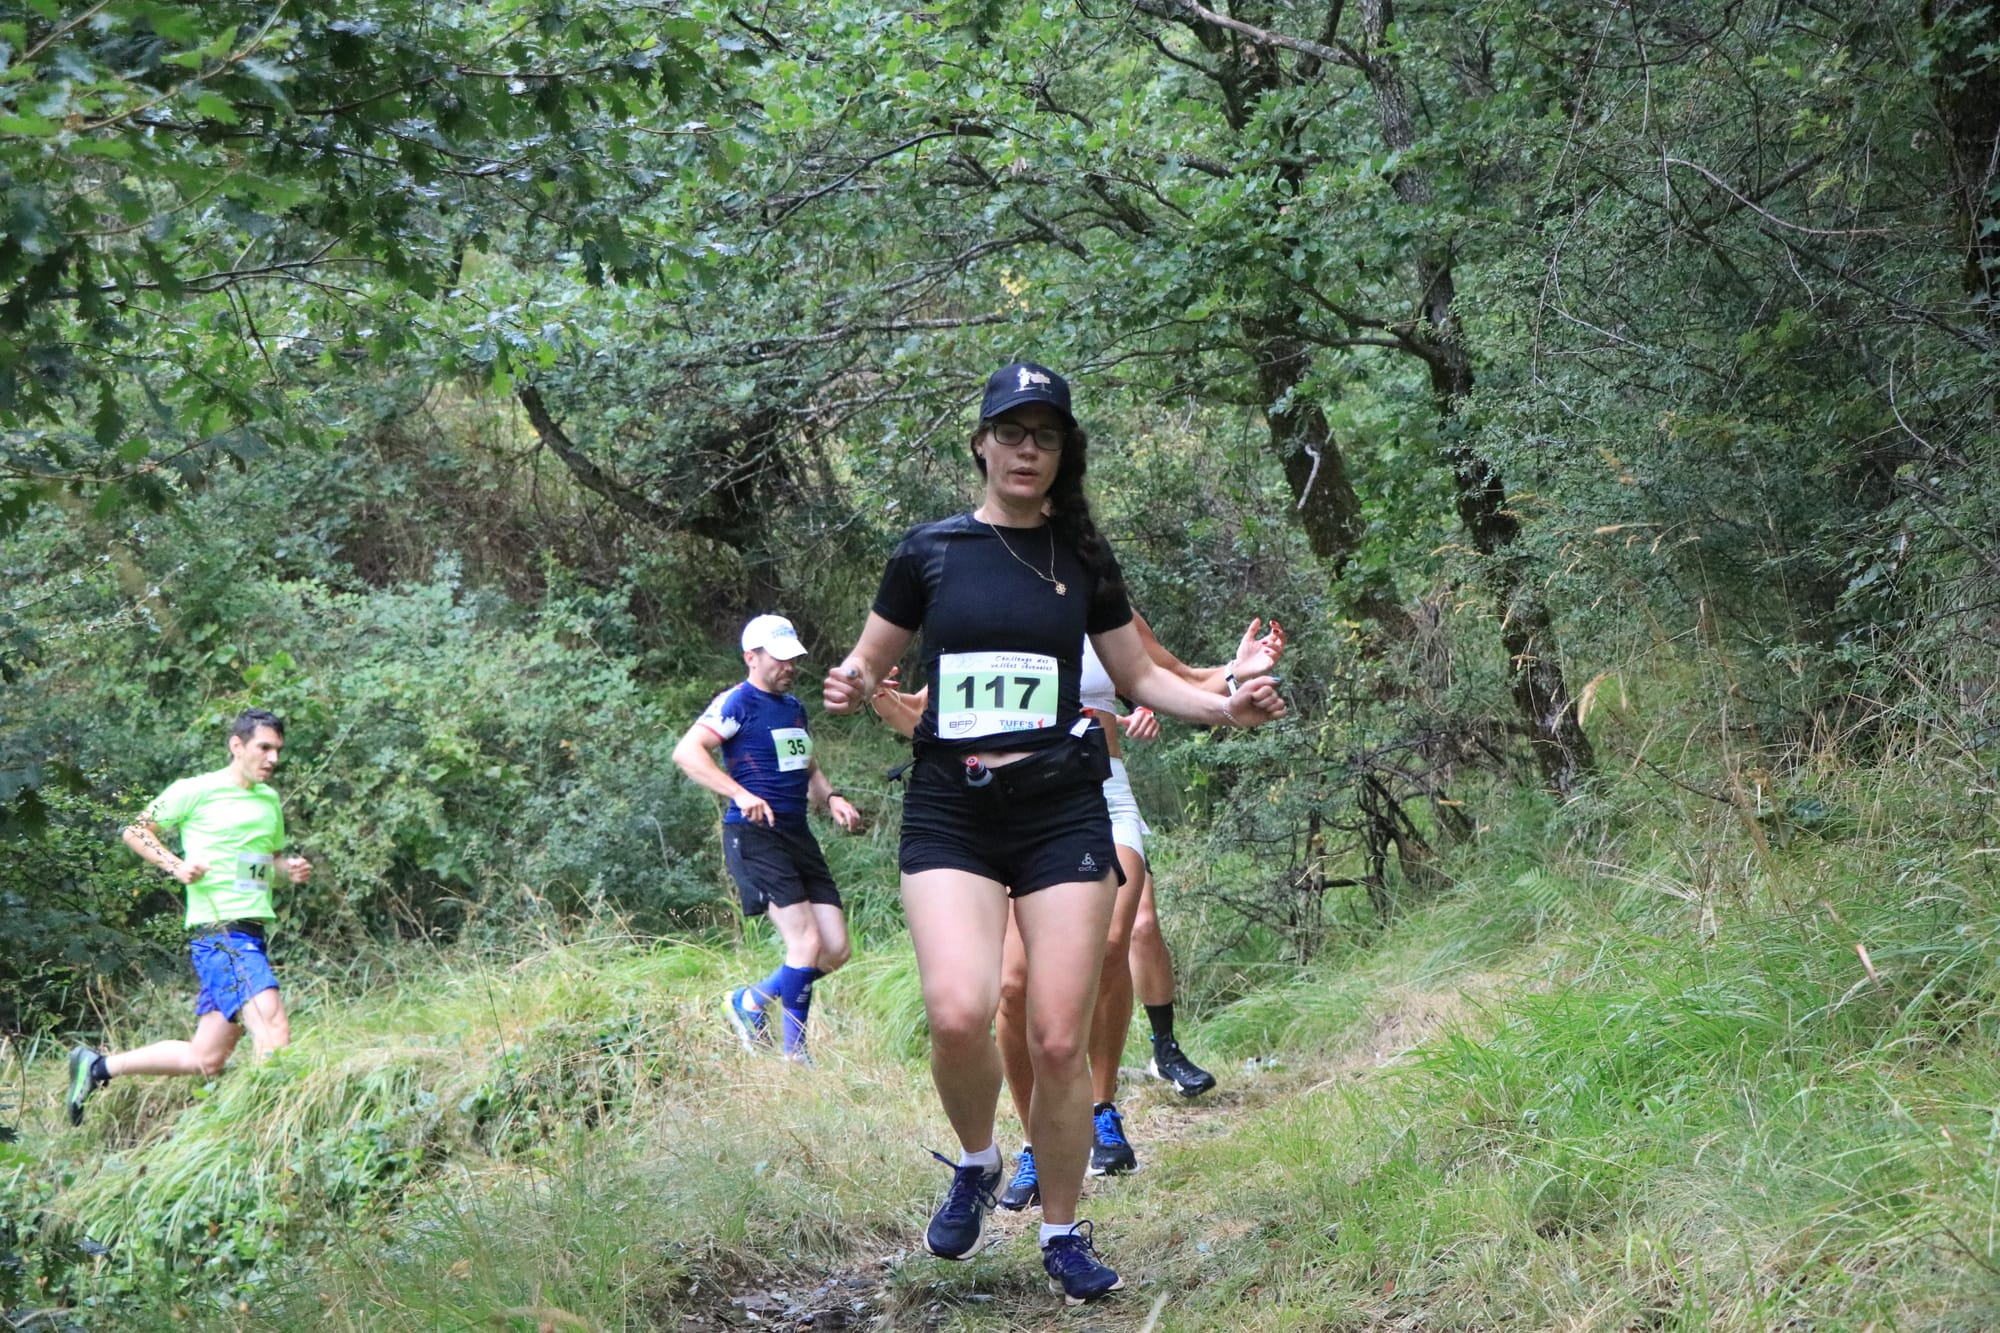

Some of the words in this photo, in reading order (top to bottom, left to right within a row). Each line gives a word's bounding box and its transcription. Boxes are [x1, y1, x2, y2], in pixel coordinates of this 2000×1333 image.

[957, 675, 1041, 710] 117
[1000, 719, 1034, 728] TUFF'S
[787, 739, 806, 755] 35
[249, 864, 266, 880] 14
